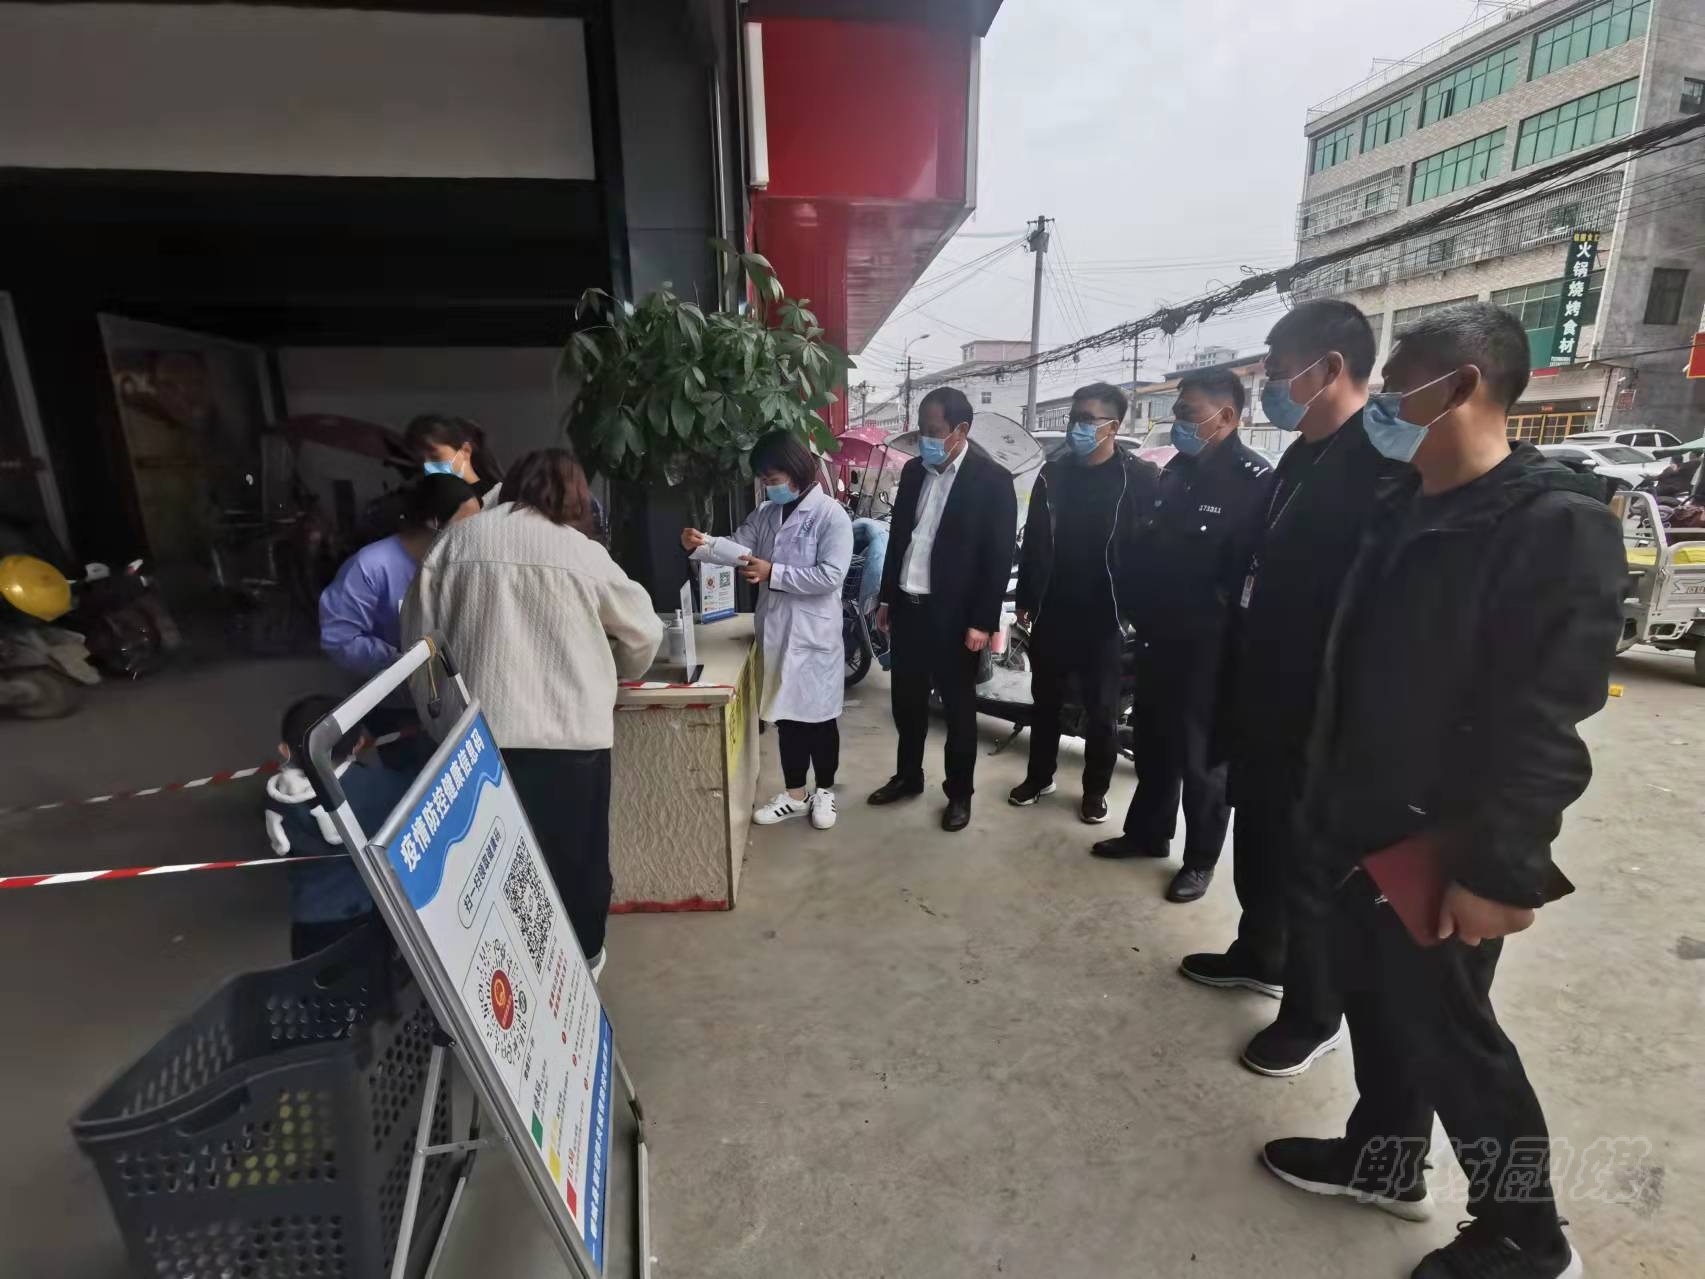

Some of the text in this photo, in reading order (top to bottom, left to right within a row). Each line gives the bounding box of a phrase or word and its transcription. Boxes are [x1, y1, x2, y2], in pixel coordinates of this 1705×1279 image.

[1558, 242, 1592, 353] 火锅烧烤食材
[401, 727, 485, 872] 疫情防控健康信息码
[464, 828, 502, 914] 扫一扫领取健康码
